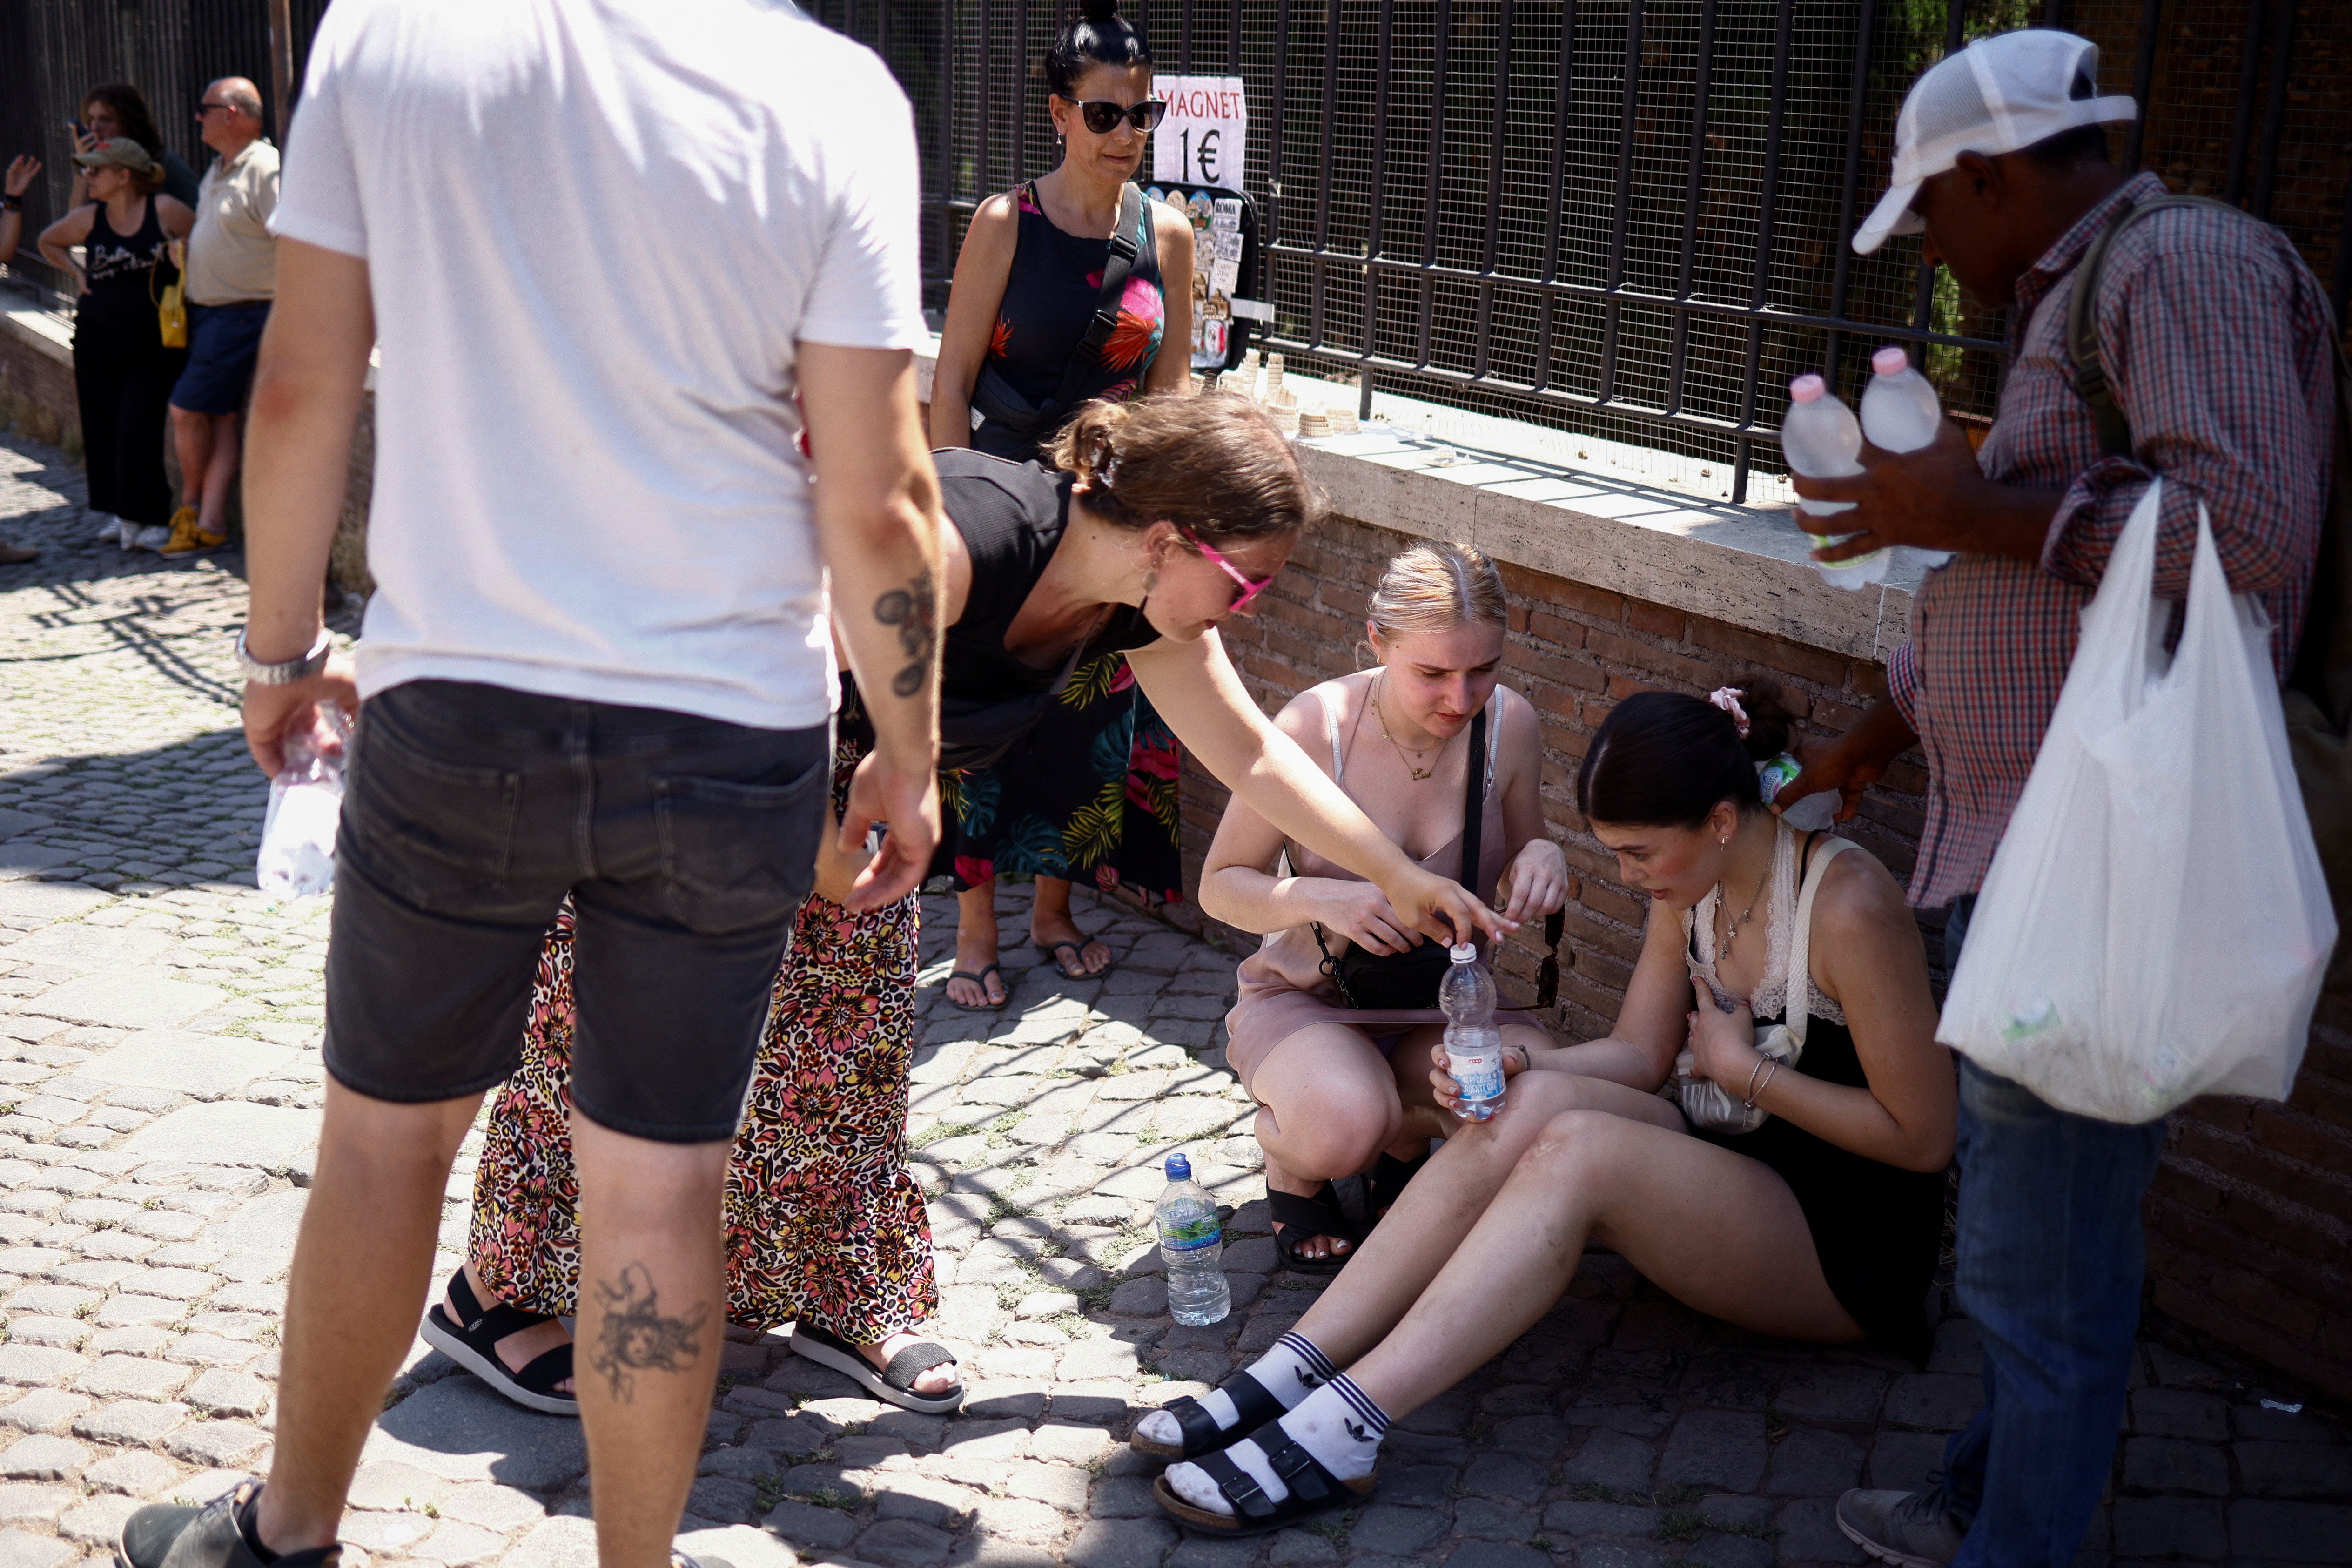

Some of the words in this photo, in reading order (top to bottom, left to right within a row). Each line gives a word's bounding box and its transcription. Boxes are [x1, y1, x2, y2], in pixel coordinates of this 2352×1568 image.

[1158, 90, 1239, 119] MAGNET
[1216, 202, 1236, 214] ROMA
[1462, 1085, 1487, 1094] ORGENTE
[469, 1319, 481, 1330] KEEN
